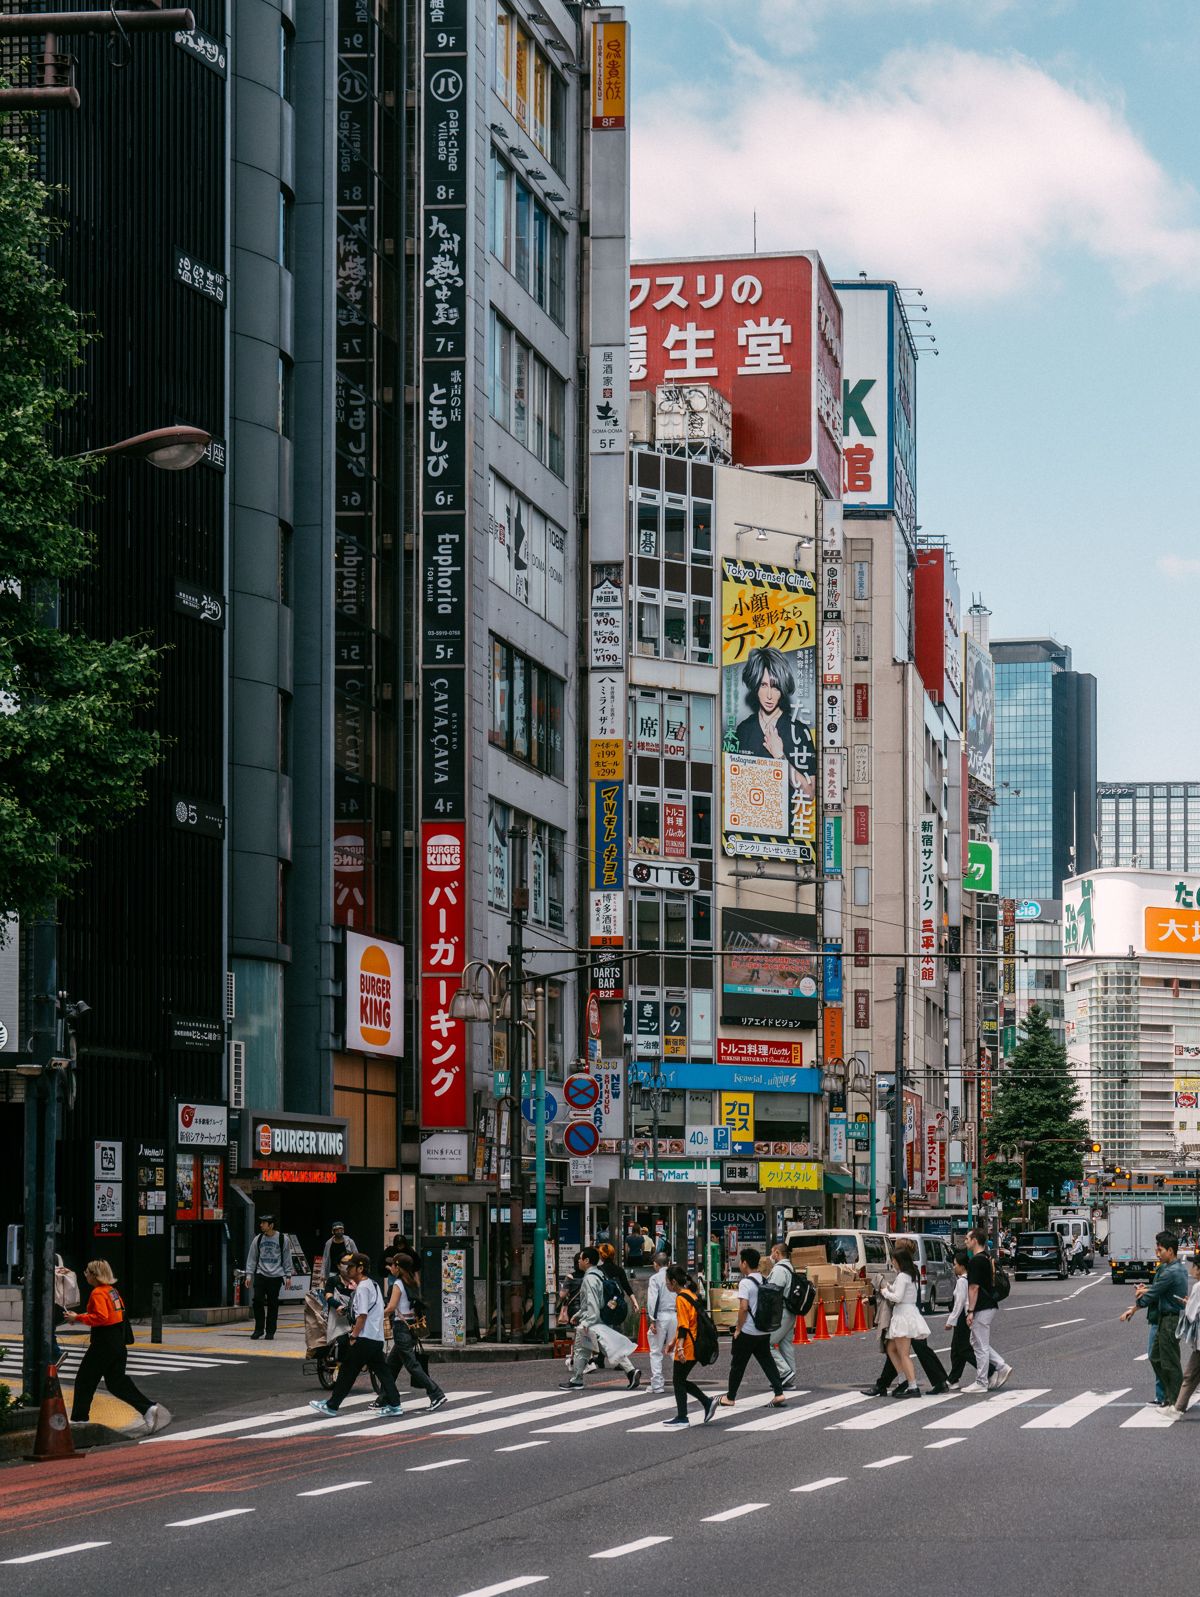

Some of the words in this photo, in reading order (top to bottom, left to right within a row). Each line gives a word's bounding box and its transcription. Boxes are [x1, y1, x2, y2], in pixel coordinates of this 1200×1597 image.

[437, 33, 456, 47] 9F
[602, 117, 616, 126] 8F
[436, 185, 455, 200] 8F
[435, 337, 455, 353] 7F
[450, 370, 462, 422] 歌声の店
[427, 384, 448, 477] ともしび
[599, 438, 616, 449] 5F
[435, 490, 454, 506] 6F
[432, 533, 461, 614] Euphoria
[725, 562, 755, 581] Tokyo
[756, 566, 786, 584] Tensei
[786, 572, 814, 590] Clinic
[732, 591, 769, 618] 小顔
[751, 605, 803, 629] 整形なら
[596, 636, 620, 645] ¥290
[723, 619, 812, 660] テンクリ
[435, 644, 454, 659] 5F
[826, 628, 837, 671] パムッカレ
[826, 674, 839, 682] 5F
[599, 686, 608, 736] ミライザカ
[723, 716, 738, 740] 日本
[723, 740, 741, 753] No.1
[789, 700, 814, 840] たいせい先生
[434, 798, 453, 813] 4F
[665, 807, 685, 817] トルコ
[666, 816, 685, 827] 料理
[826, 822, 834, 861] FamilyMart
[427, 846, 460, 854] BURGER
[738, 843, 761, 853] テンクリ
[762, 845, 799, 857] たいせい先生
[427, 854, 460, 865] KING
[921, 820, 934, 911] 新宿サンパーク
[602, 893, 613, 935] 博多酒場
[601, 937, 613, 945] B1
[921, 919, 934, 982] 三平本館
[593, 967, 621, 978] DARTS
[360, 973, 391, 1000] BURGER
[428, 881, 459, 1097] バーガーキング
[598, 978, 615, 989] BAR
[599, 990, 615, 999] B2F
[360, 999, 392, 1030] KING
[741, 1016, 774, 1027] リアエイド
[775, 1018, 801, 1028] ビジョン
[670, 1046, 682, 1055] 3F
[719, 1042, 769, 1056] トルコ料理
[792, 1045, 801, 1064] 5F
[611, 1073, 622, 1100] NEW
[725, 1101, 750, 1115] プロ
[725, 1117, 750, 1132] ミス
[179, 1130, 227, 1144] 新宿シアタートップス
[273, 1128, 317, 1155] BURGER
[318, 1130, 343, 1156] KING
[717, 1129, 726, 1143] P
[926, 1124, 938, 1178] 三平ストア
[726, 1166, 749, 1179] 囲碁
[767, 1170, 812, 1182] クリスタル
[711, 1211, 766, 1222] SUBNAD
